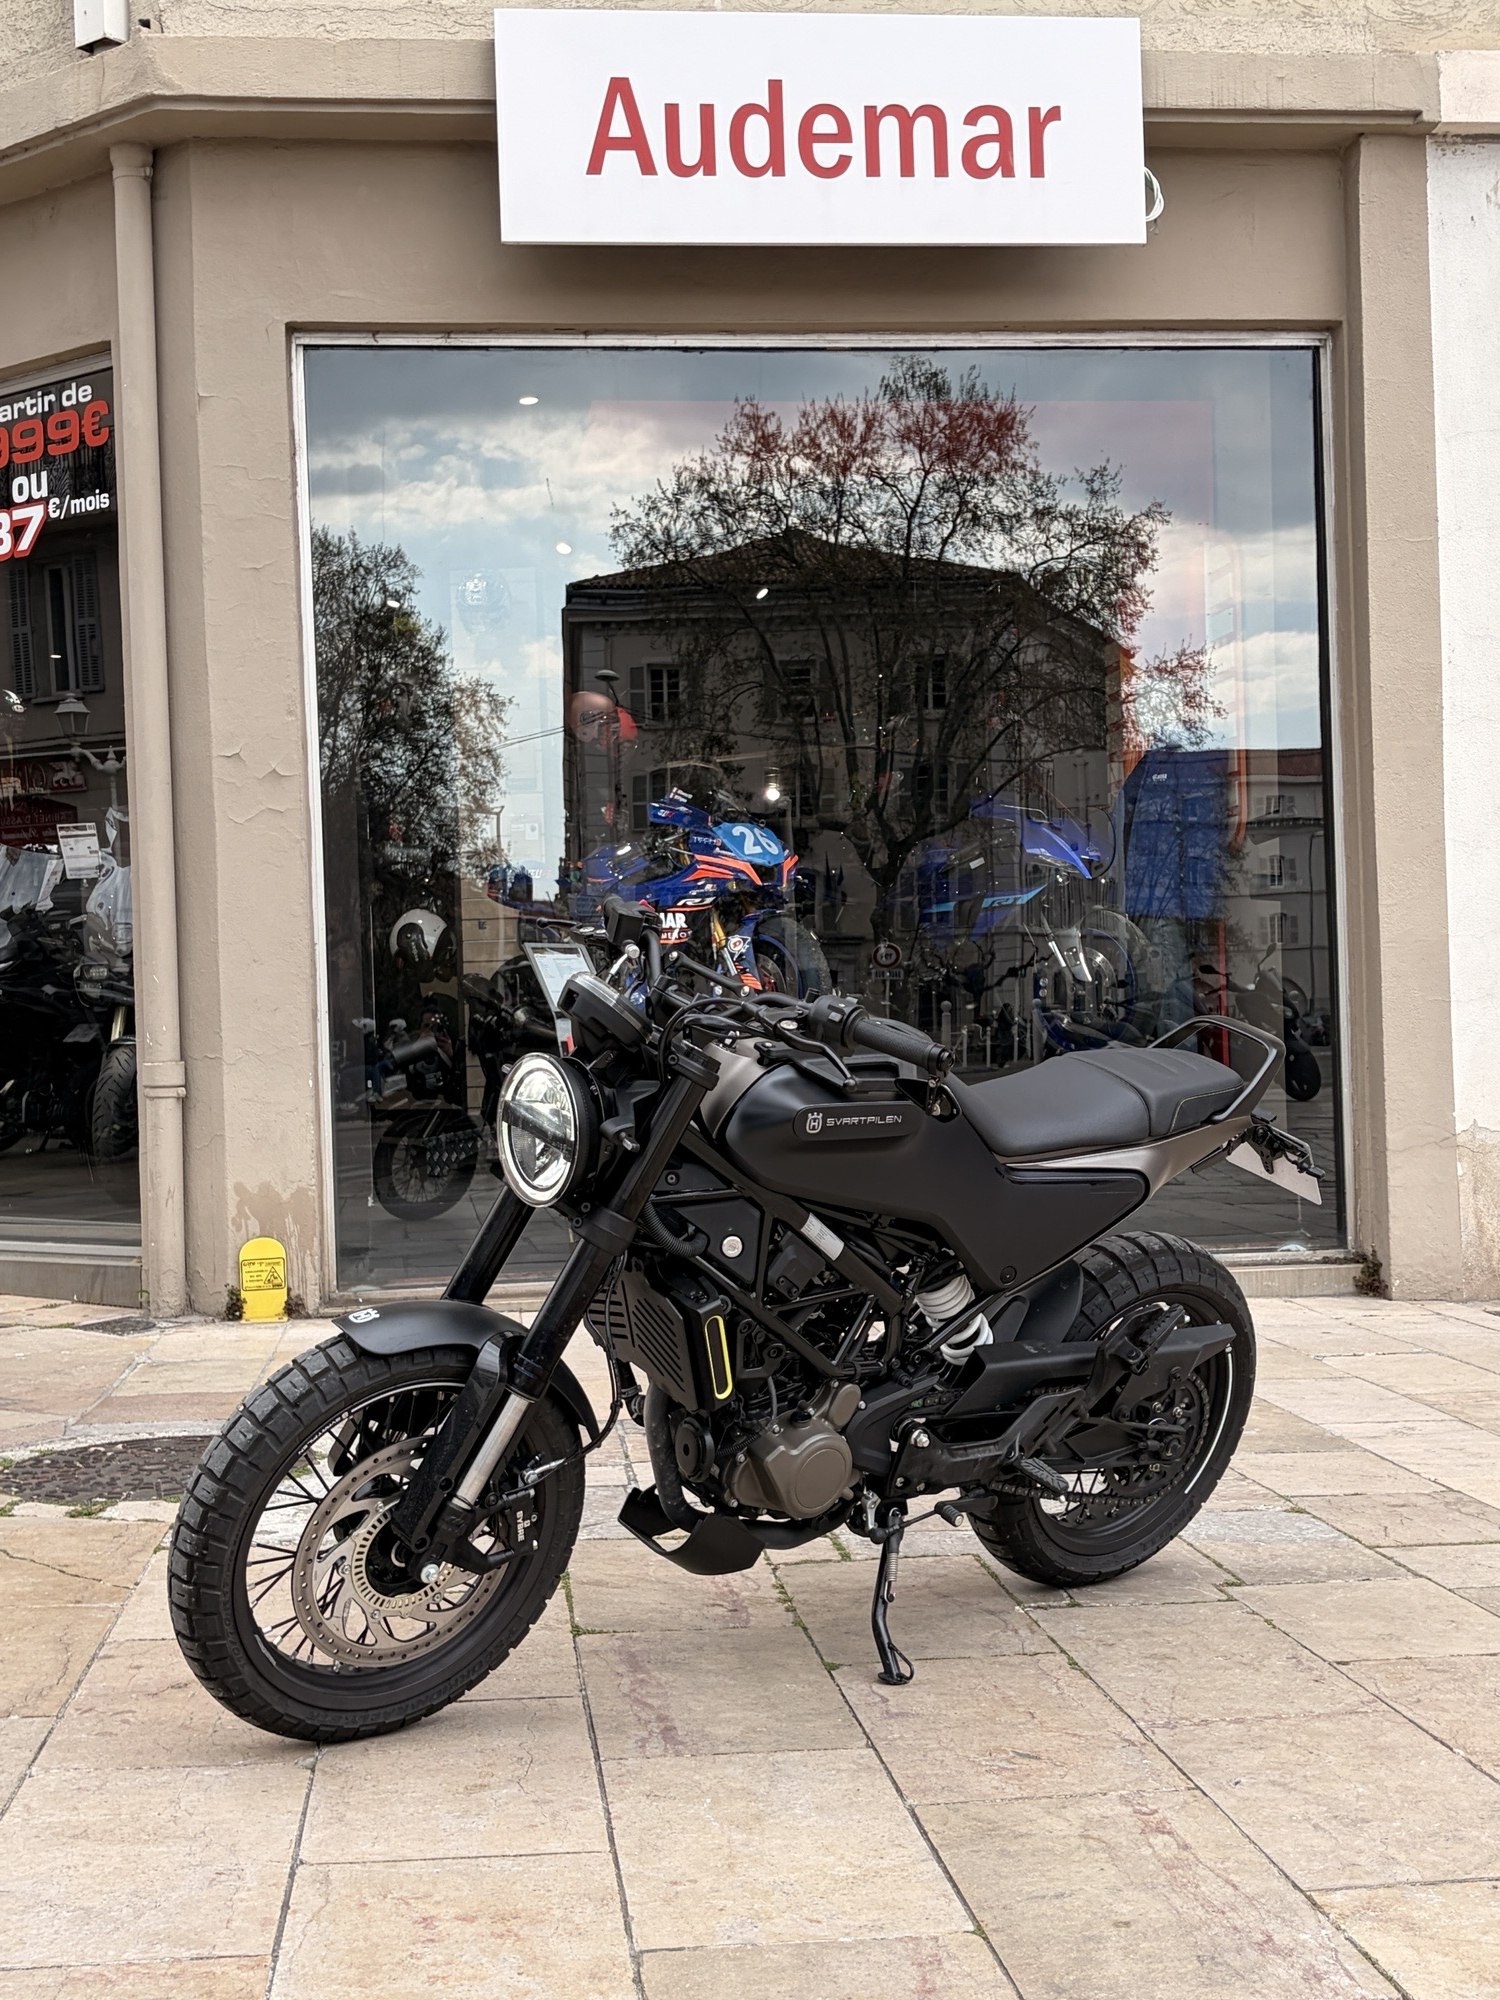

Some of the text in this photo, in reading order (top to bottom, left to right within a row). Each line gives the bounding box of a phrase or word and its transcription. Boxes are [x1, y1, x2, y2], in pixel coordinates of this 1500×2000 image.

[586, 76, 1061, 180] Audemar
[62, 382, 92, 407] de
[0, 400, 109, 469] 99€
[12, 470, 48, 503] ou
[732, 825, 779, 855] 26
[826, 1115, 902, 1127] SVARTPILEN
[516, 1510, 525, 1542] BYBRE
